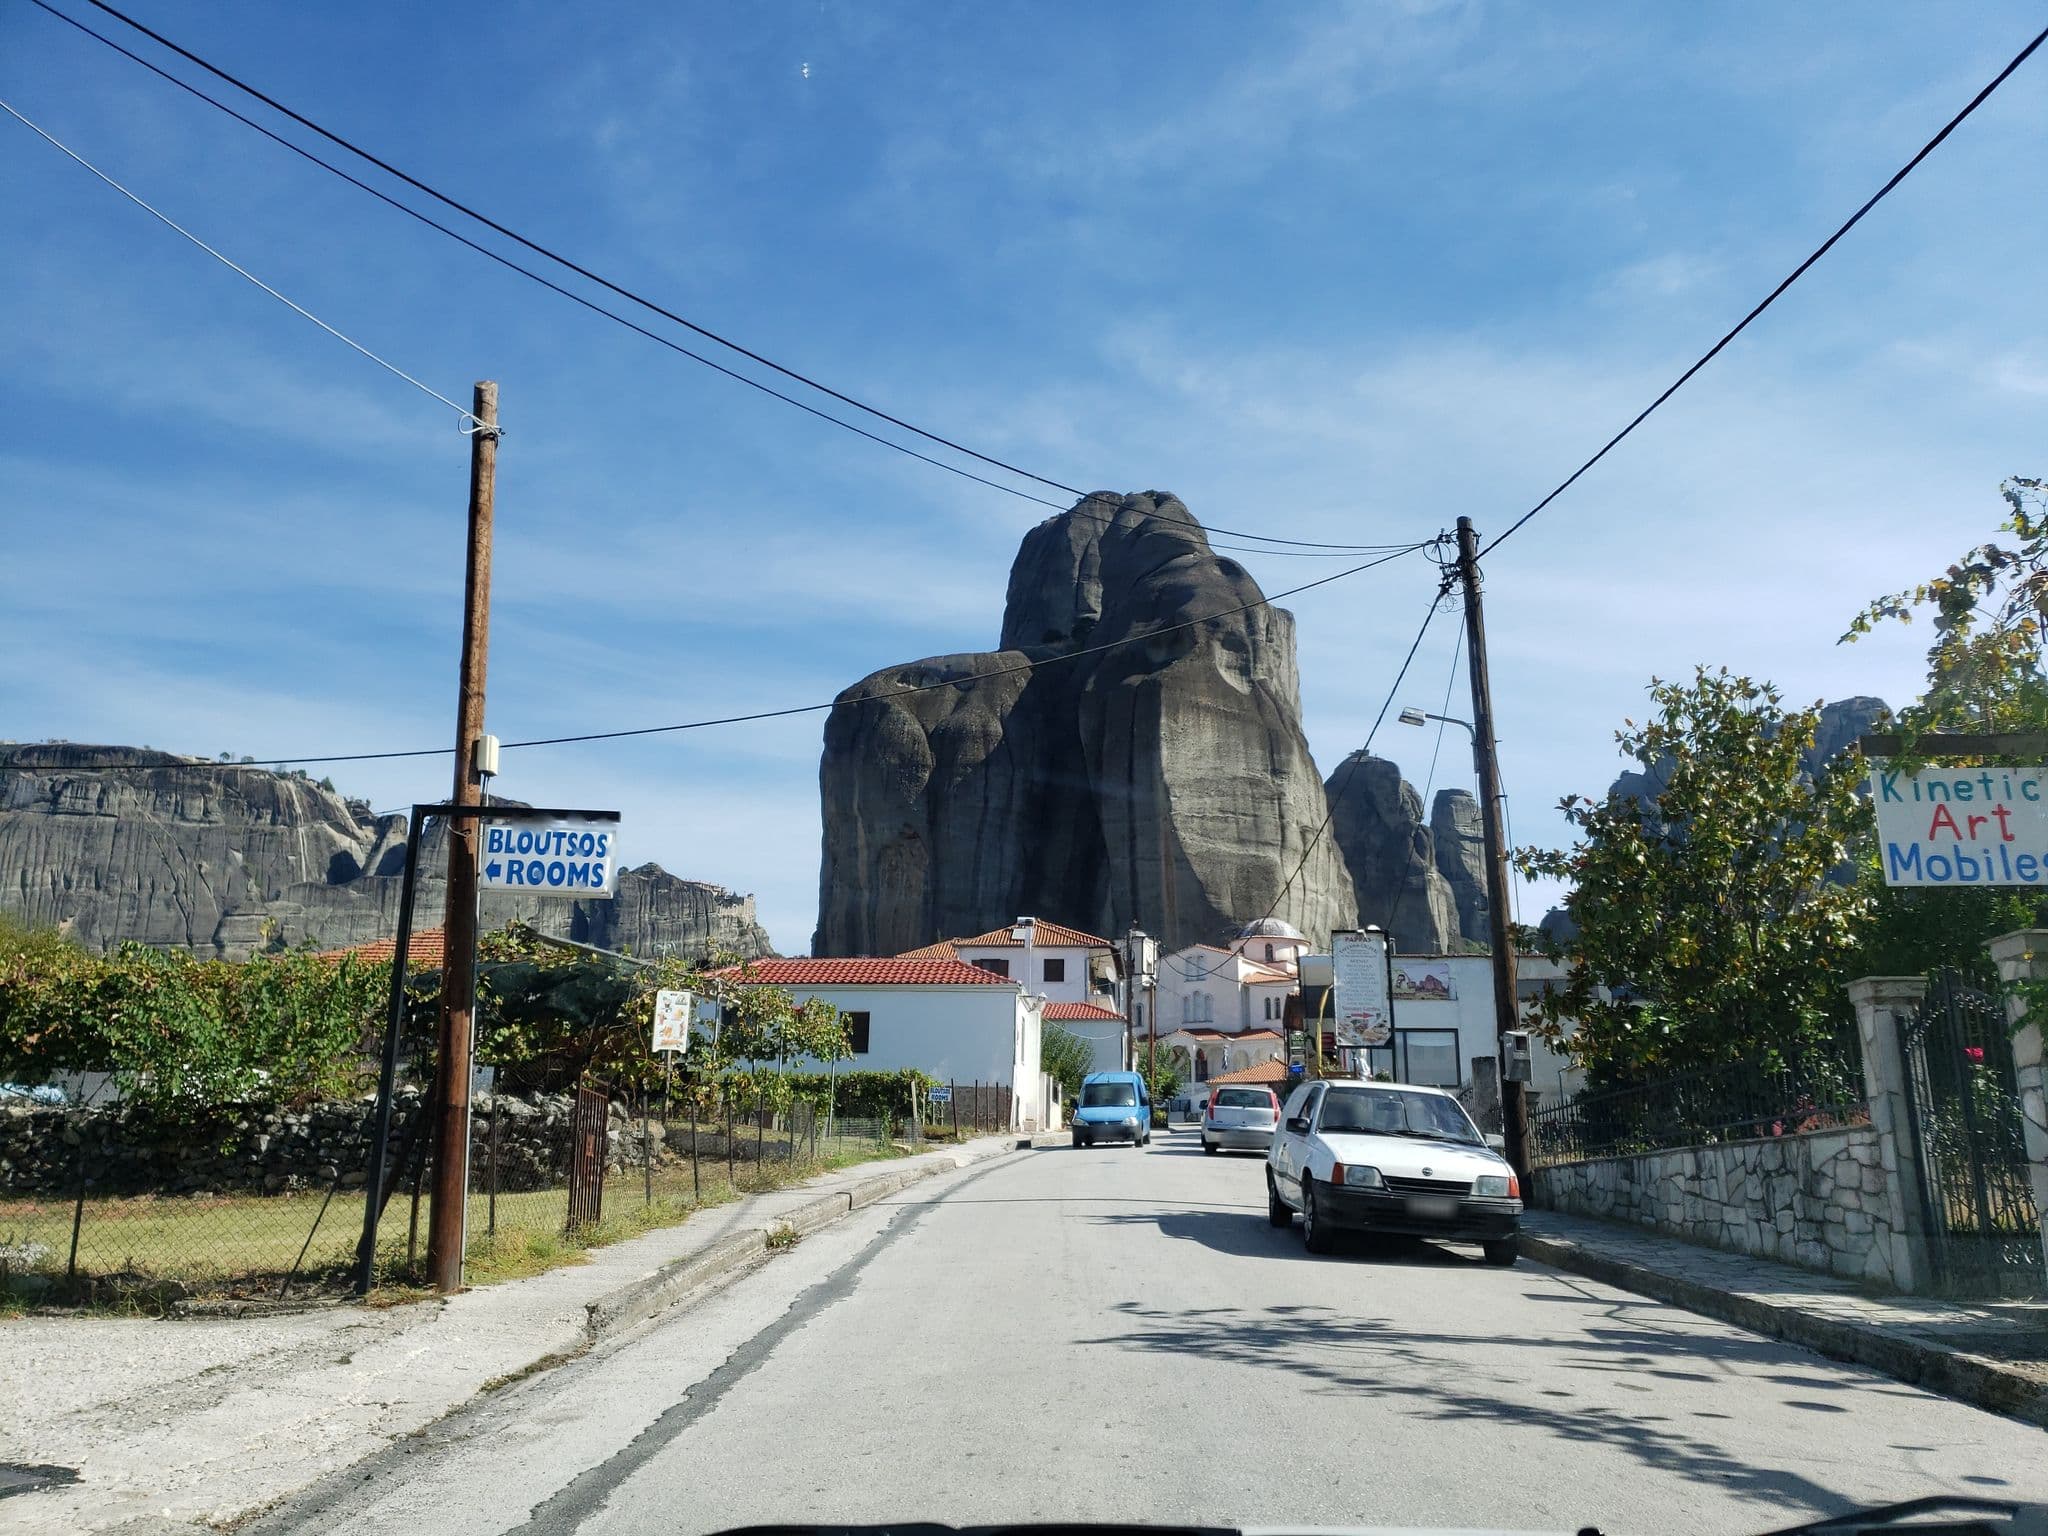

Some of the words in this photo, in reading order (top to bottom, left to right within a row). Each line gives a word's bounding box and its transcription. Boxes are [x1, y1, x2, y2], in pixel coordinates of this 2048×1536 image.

[1881, 769, 2041, 803] Kinetic
[1929, 803, 2016, 842] Art
[487, 828, 608, 859] BLOUTSOS
[505, 859, 605, 888] ROOMS
[1888, 842, 2048, 882] Mobile
